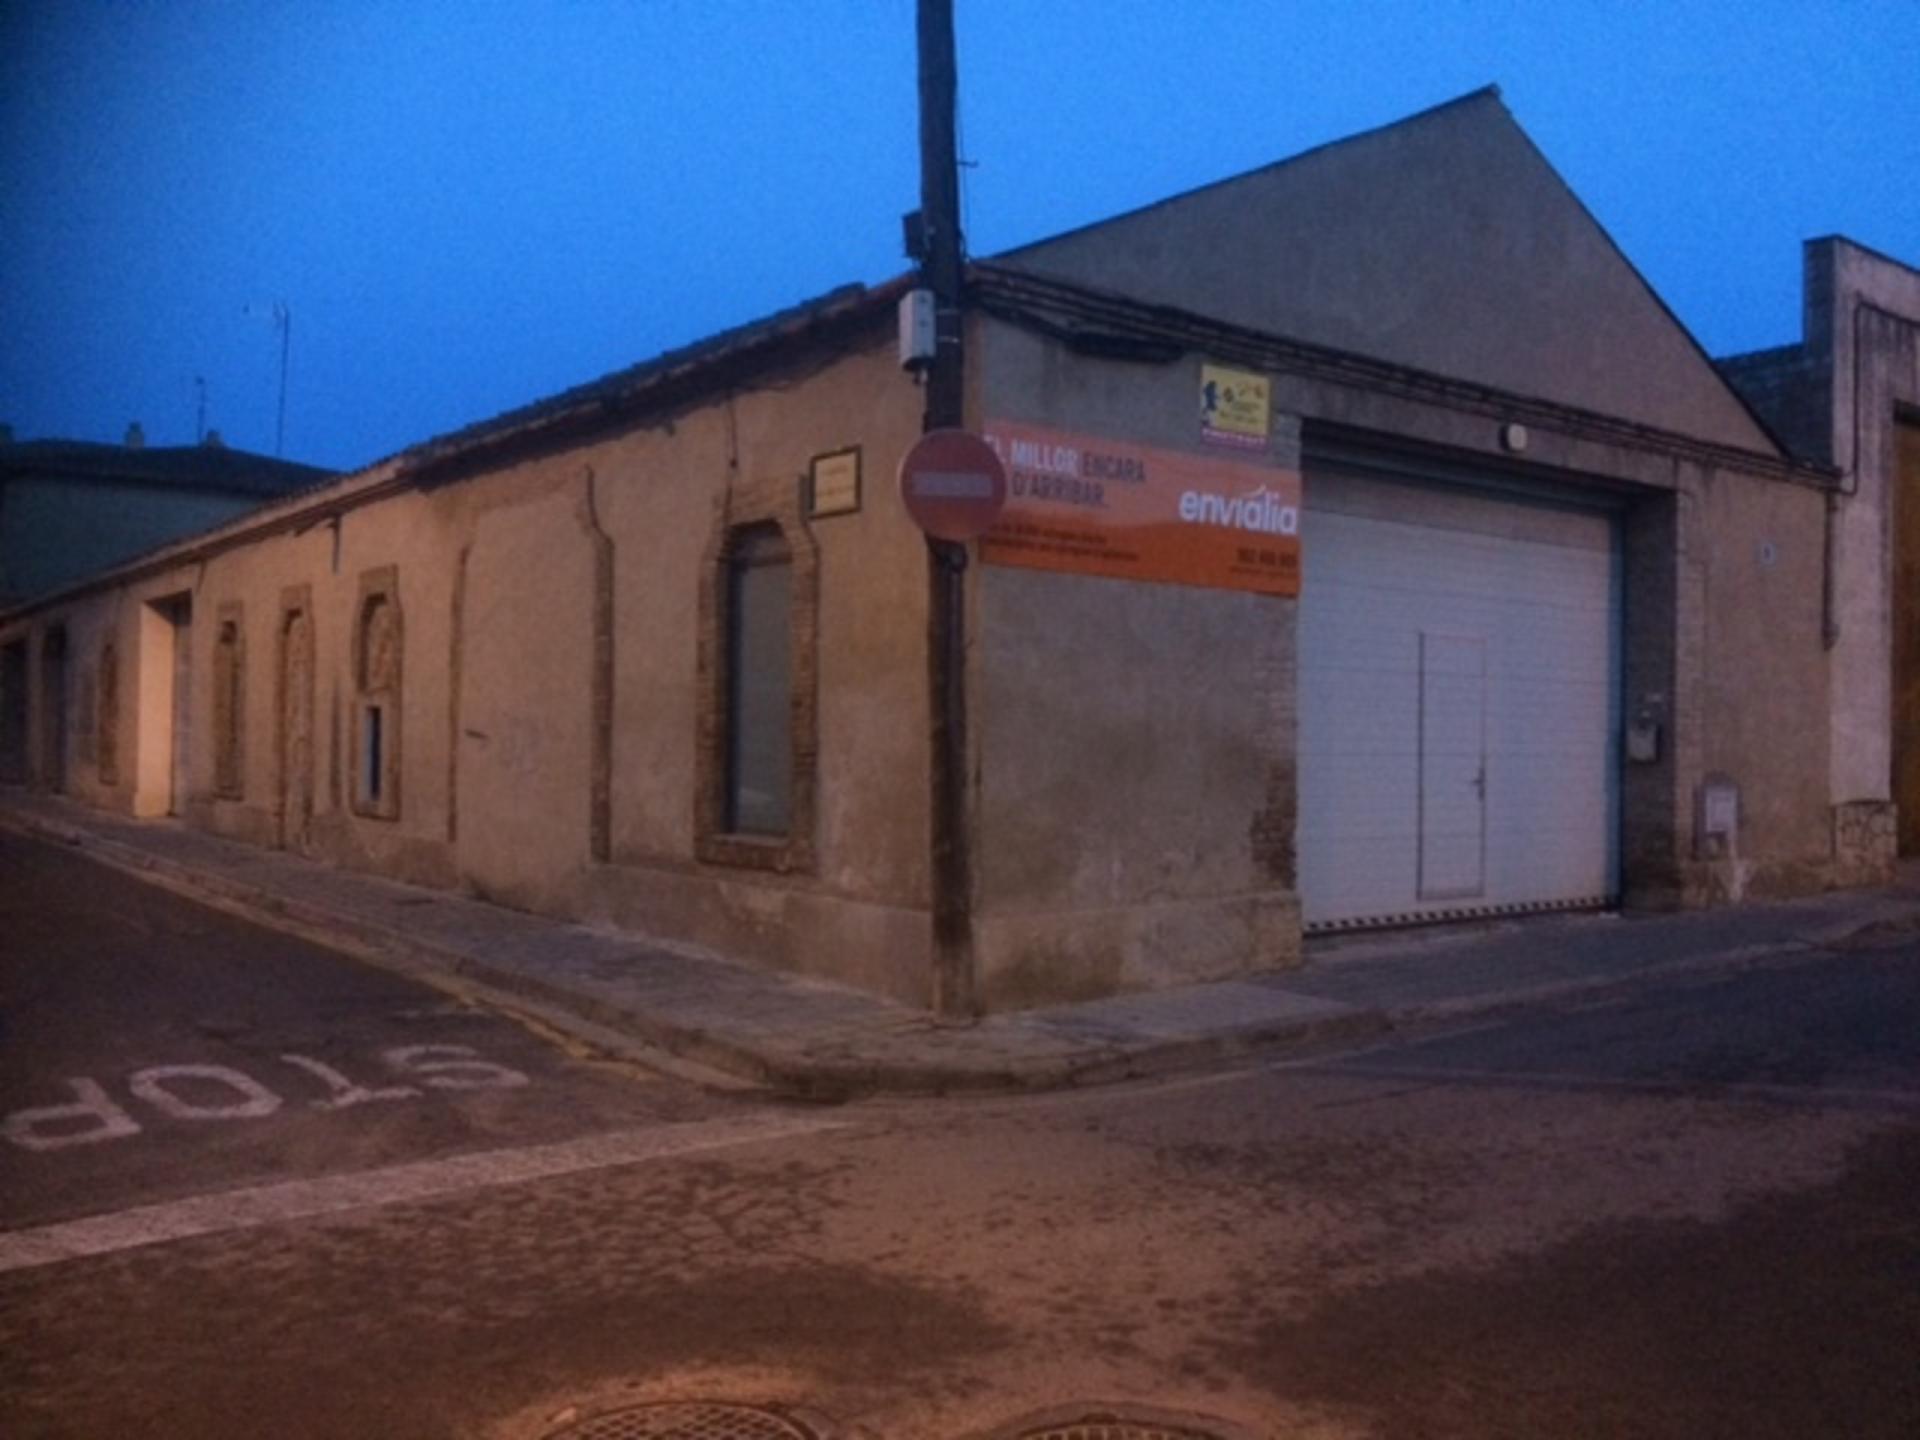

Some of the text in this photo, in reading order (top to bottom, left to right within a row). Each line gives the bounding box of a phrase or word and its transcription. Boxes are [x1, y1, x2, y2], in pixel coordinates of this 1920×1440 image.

[1010, 437, 1079, 478] MILLOR
[1082, 450, 1146, 483] ENCARA
[2, 1043, 530, 1151] STOP
